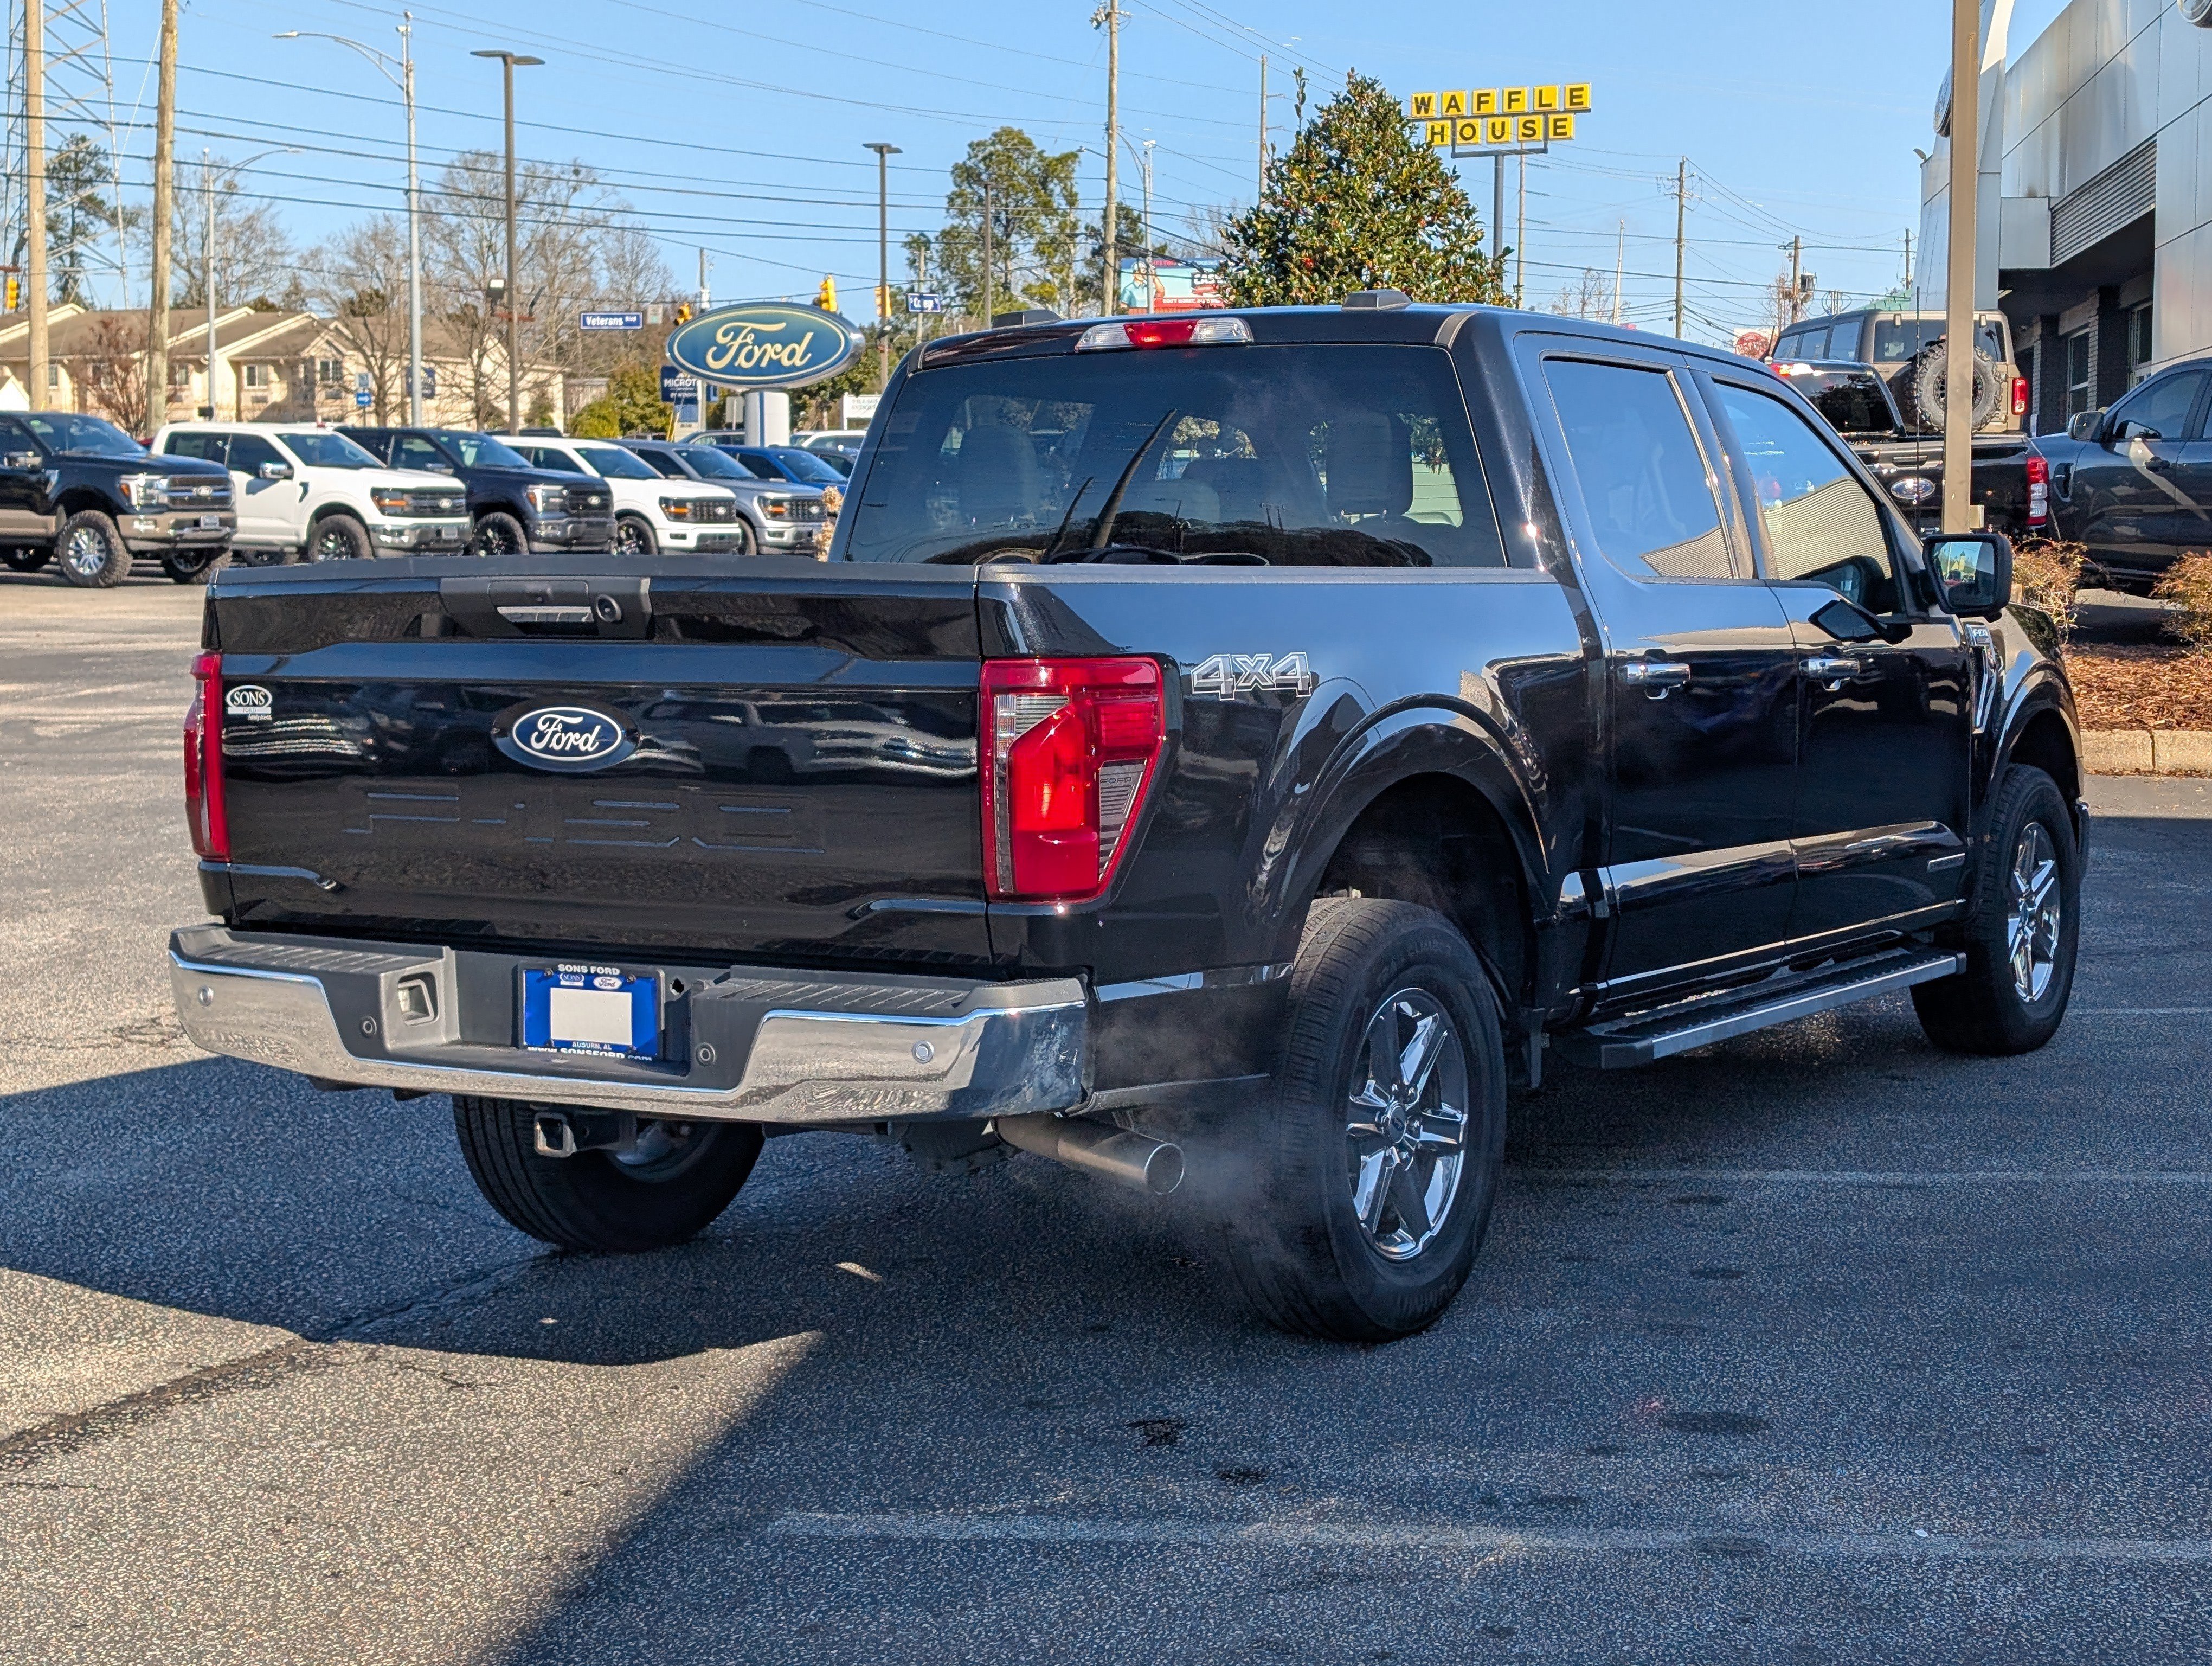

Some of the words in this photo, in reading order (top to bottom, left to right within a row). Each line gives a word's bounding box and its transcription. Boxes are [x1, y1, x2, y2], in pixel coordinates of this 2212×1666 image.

[1414, 87, 1584, 116] WAFFLE
[1430, 117, 1568, 143] HOUSE
[586, 316, 623, 325] Veterans
[706, 321, 814, 369] Ford
[663, 379, 699, 387] MICROT
[234, 691, 265, 706] SONS
[530, 714, 601, 752] Ford
[558, 964, 588, 973] SONS
[590, 966, 620, 975] FORD
[599, 978, 616, 988] Ford
[572, 1041, 602, 1050] AUBURN,
